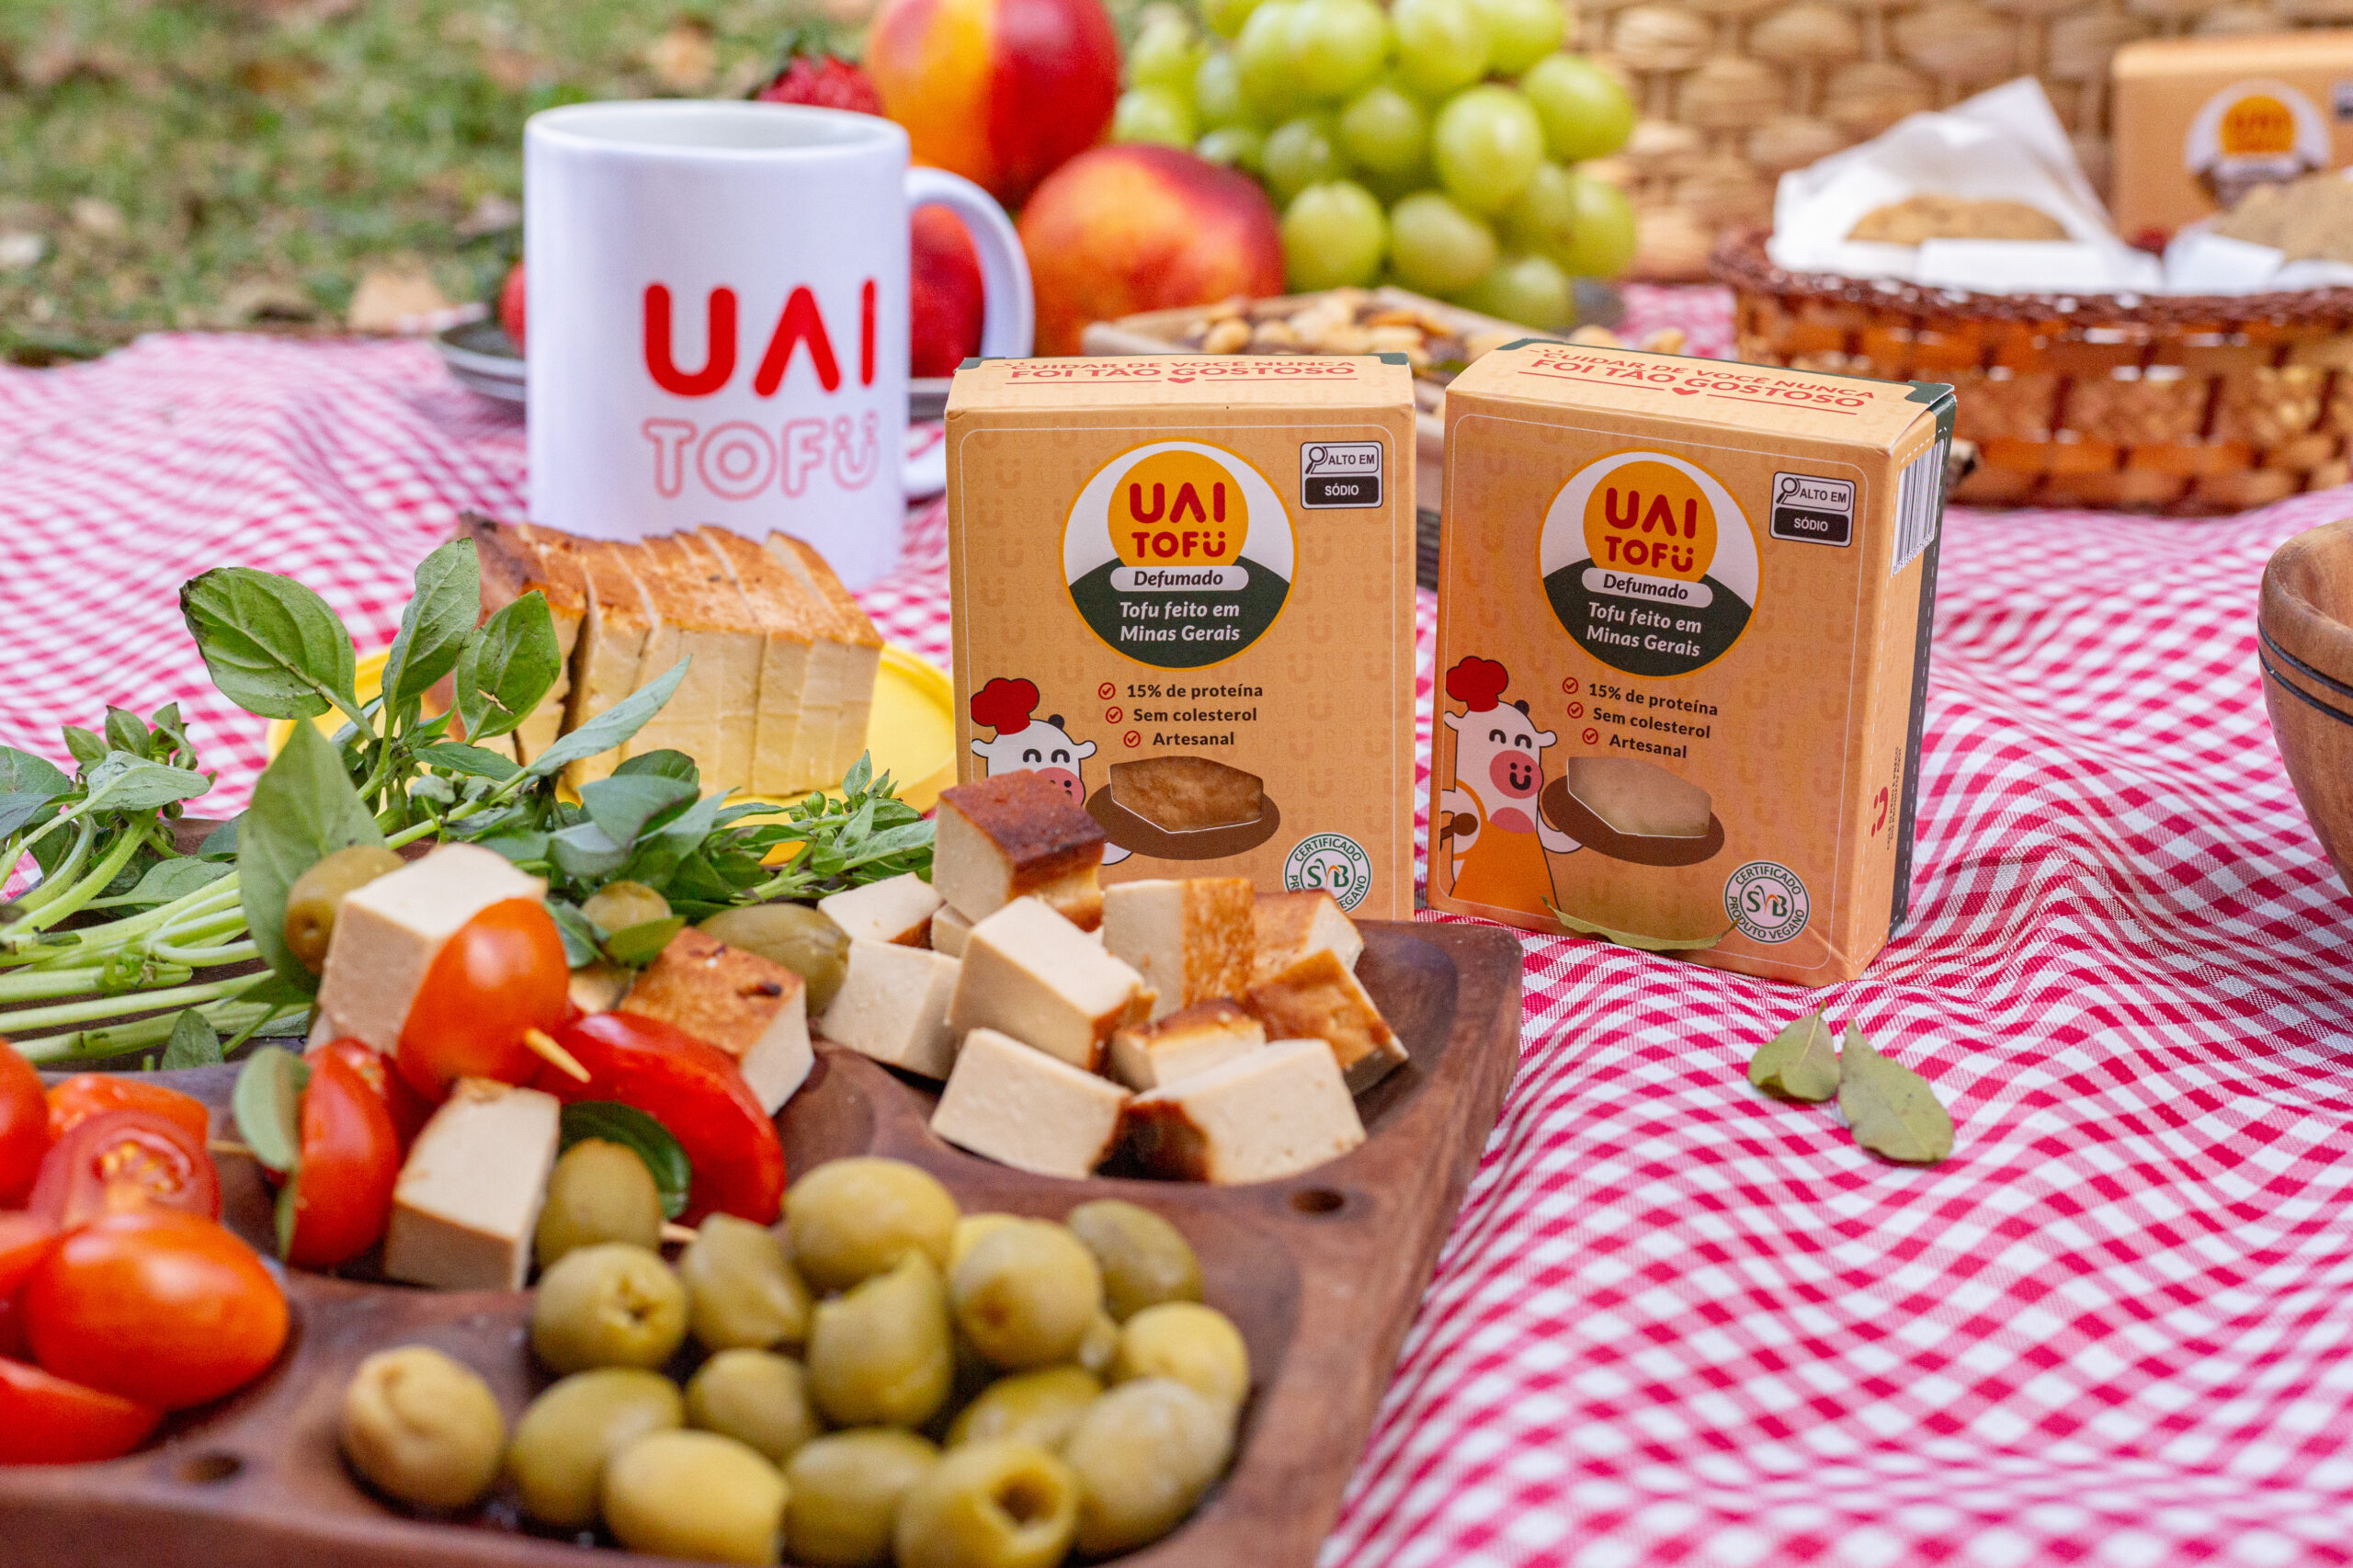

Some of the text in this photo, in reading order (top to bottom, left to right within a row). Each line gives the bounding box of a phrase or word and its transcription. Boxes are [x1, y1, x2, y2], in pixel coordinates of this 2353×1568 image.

[642, 278, 877, 399] UAI
[1012, 369, 1074, 379] FOI
[1171, 367, 1355, 376] GOSTOSO
[1530, 358, 1865, 408] FOI TÃO GOSTOSO
[1543, 353, 1643, 369] CUIDAR
[1651, 364, 1690, 374] DE
[1775, 381, 1875, 399] NUNCA
[1328, 454, 1375, 465] ALTO EM
[1130, 482, 1226, 524] UAI
[1324, 483, 1359, 496] SÓDIO
[1800, 487, 1847, 504] ALTO EM
[1605, 487, 1698, 540] UAI
[1793, 516, 1828, 532] SÓDIO
[1133, 569, 1223, 588] Defumado
[1603, 573, 1688, 600] Defumado
[1120, 600, 1240, 620] Tofu feito em
[1588, 601, 1702, 634] Tofu feito em
[1120, 624, 1240, 642] Minas Gerais
[1586, 624, 1701, 657] Minas Gerais
[1127, 684, 1263, 700] 15% de proteína
[1589, 683, 1718, 716] 15% de proteína
[1133, 708, 1256, 722] Sem colesterol
[1593, 707, 1711, 739] Sem colesterol
[1153, 732, 1234, 746] Artesanal
[1609, 733, 1688, 758] Artesanal
[1294, 837, 1362, 862] CERTIFICADO
[1338, 875, 1367, 909] EGANO
[1735, 866, 1802, 895] CERTIFICADO
[1729, 895, 1767, 938] PRODUTO
[1768, 909, 1805, 939] VEGANO
